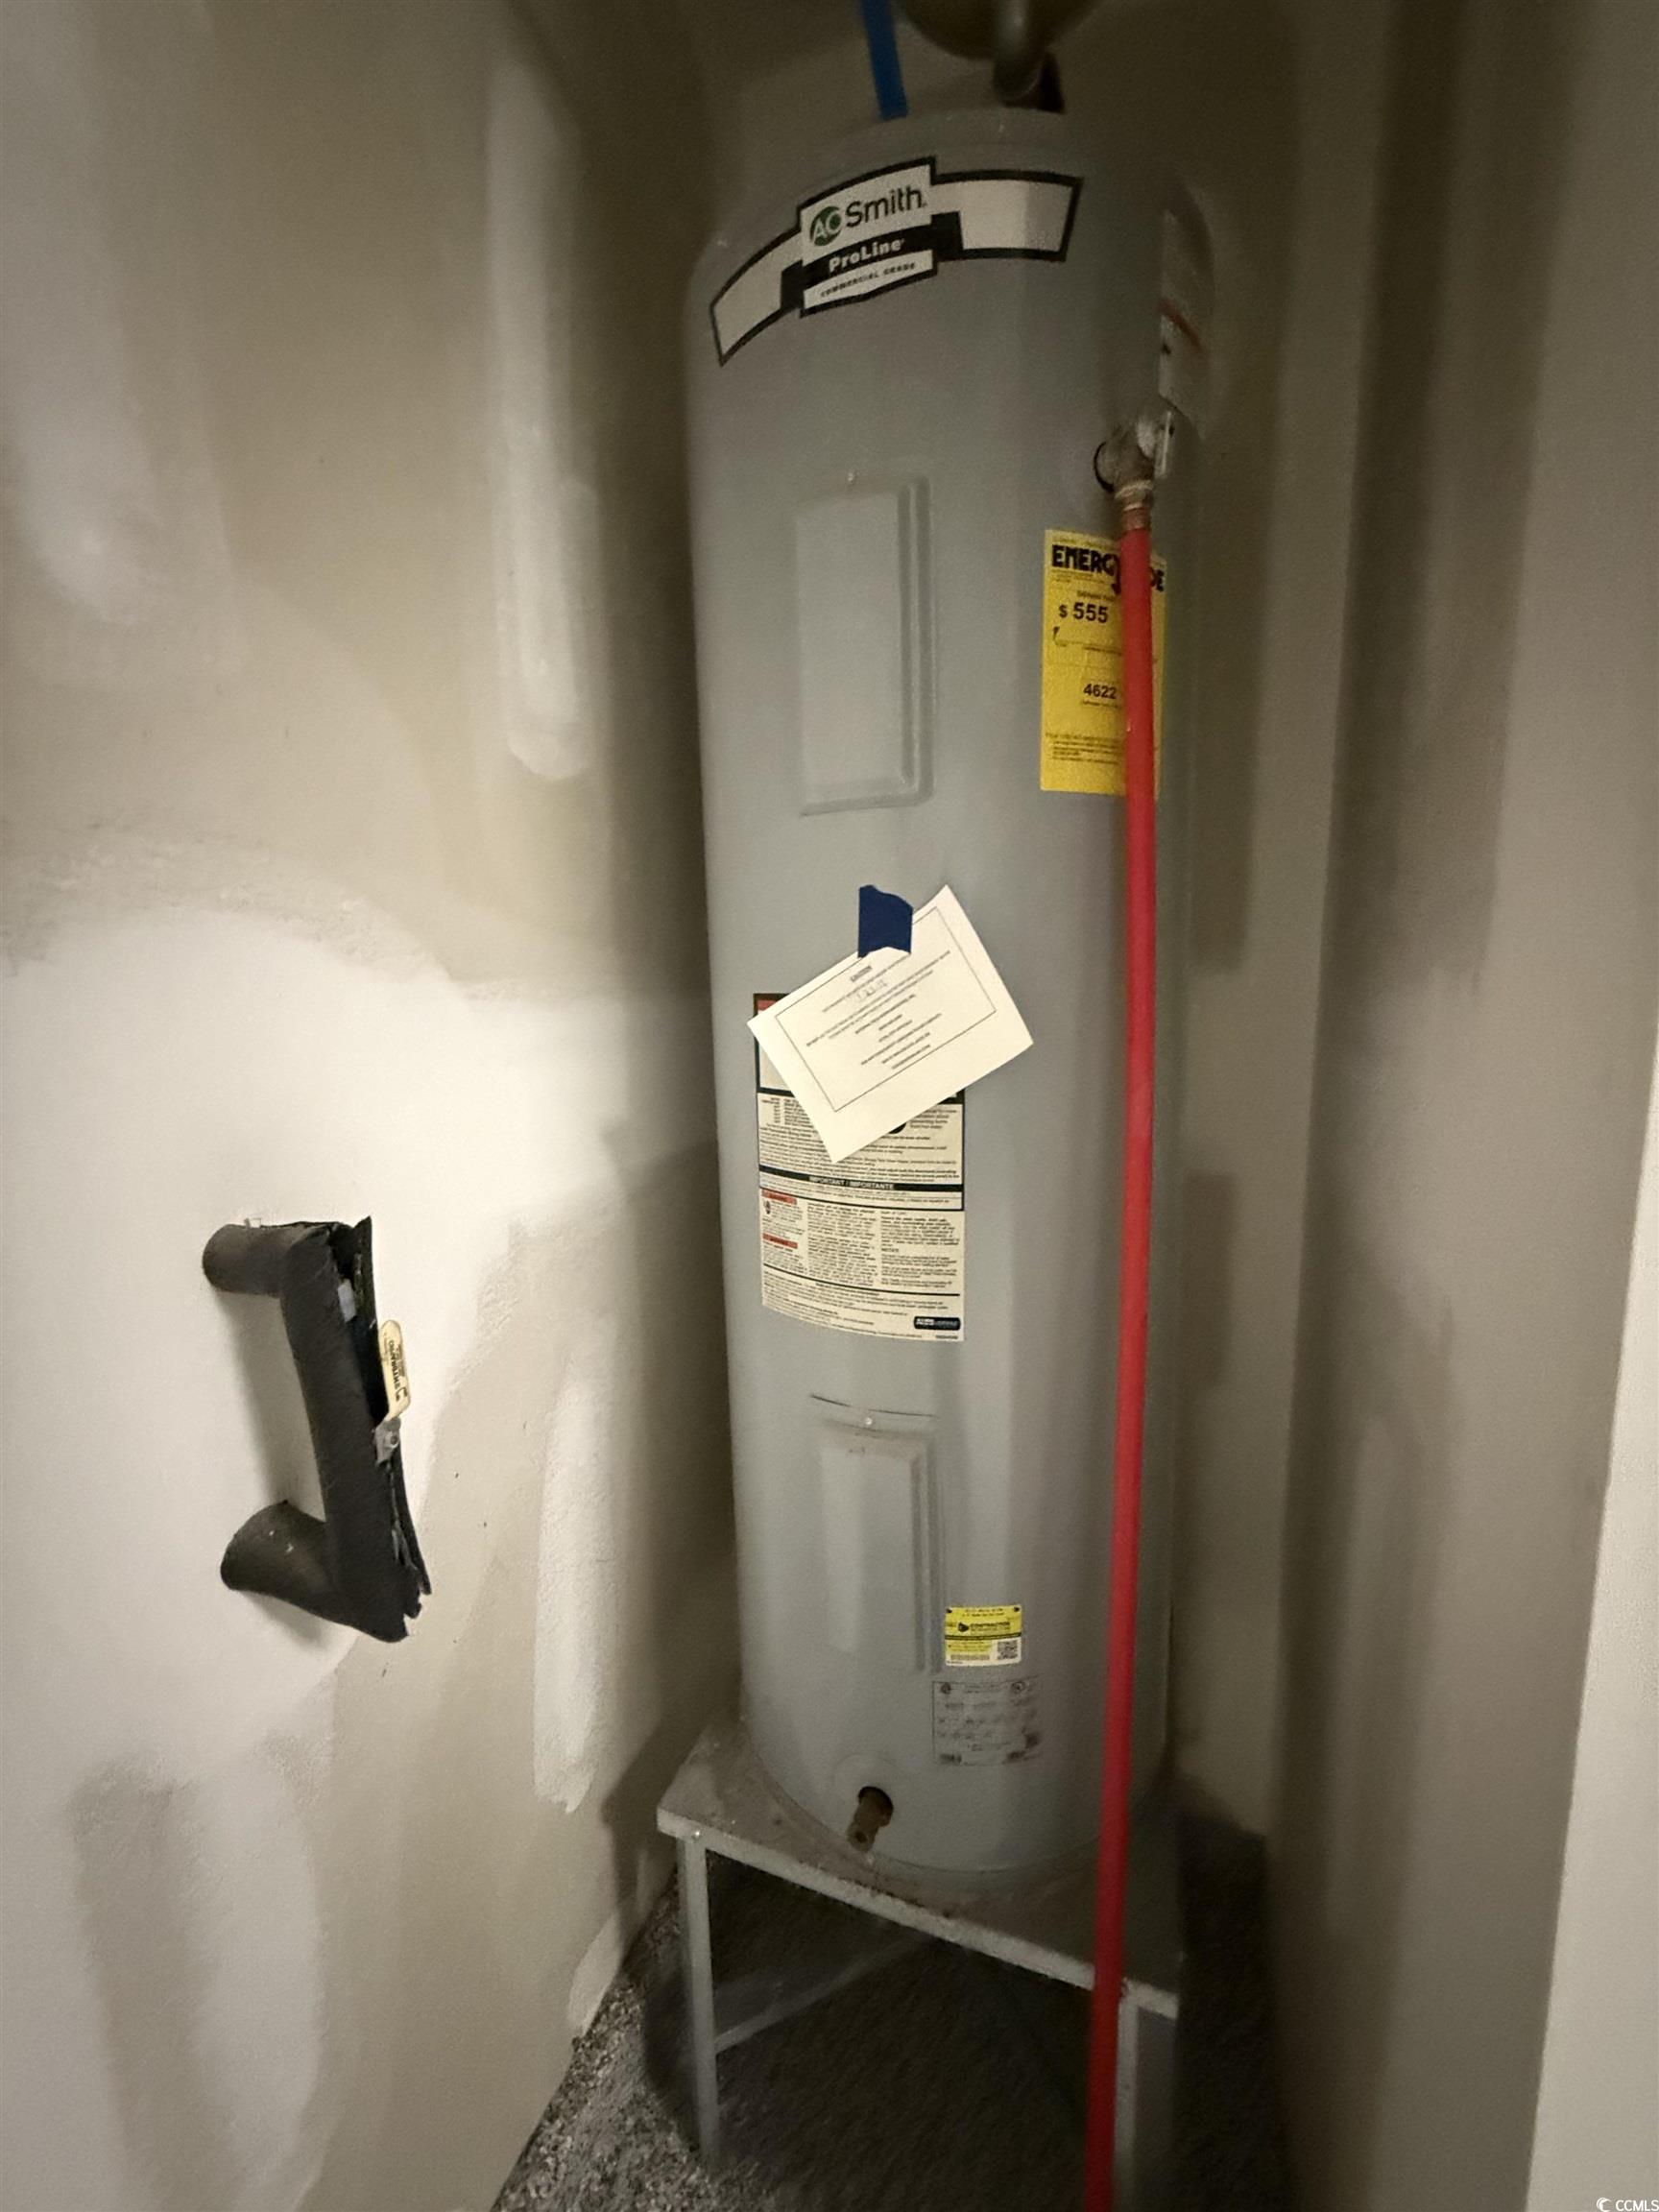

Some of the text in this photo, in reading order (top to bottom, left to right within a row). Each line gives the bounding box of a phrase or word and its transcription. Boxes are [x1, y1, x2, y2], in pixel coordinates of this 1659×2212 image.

[846, 186, 923, 228] Smith
[829, 241, 902, 273] ProLine
[1073, 602, 1108, 623] 555
[1084, 684, 1118, 699] 4622
